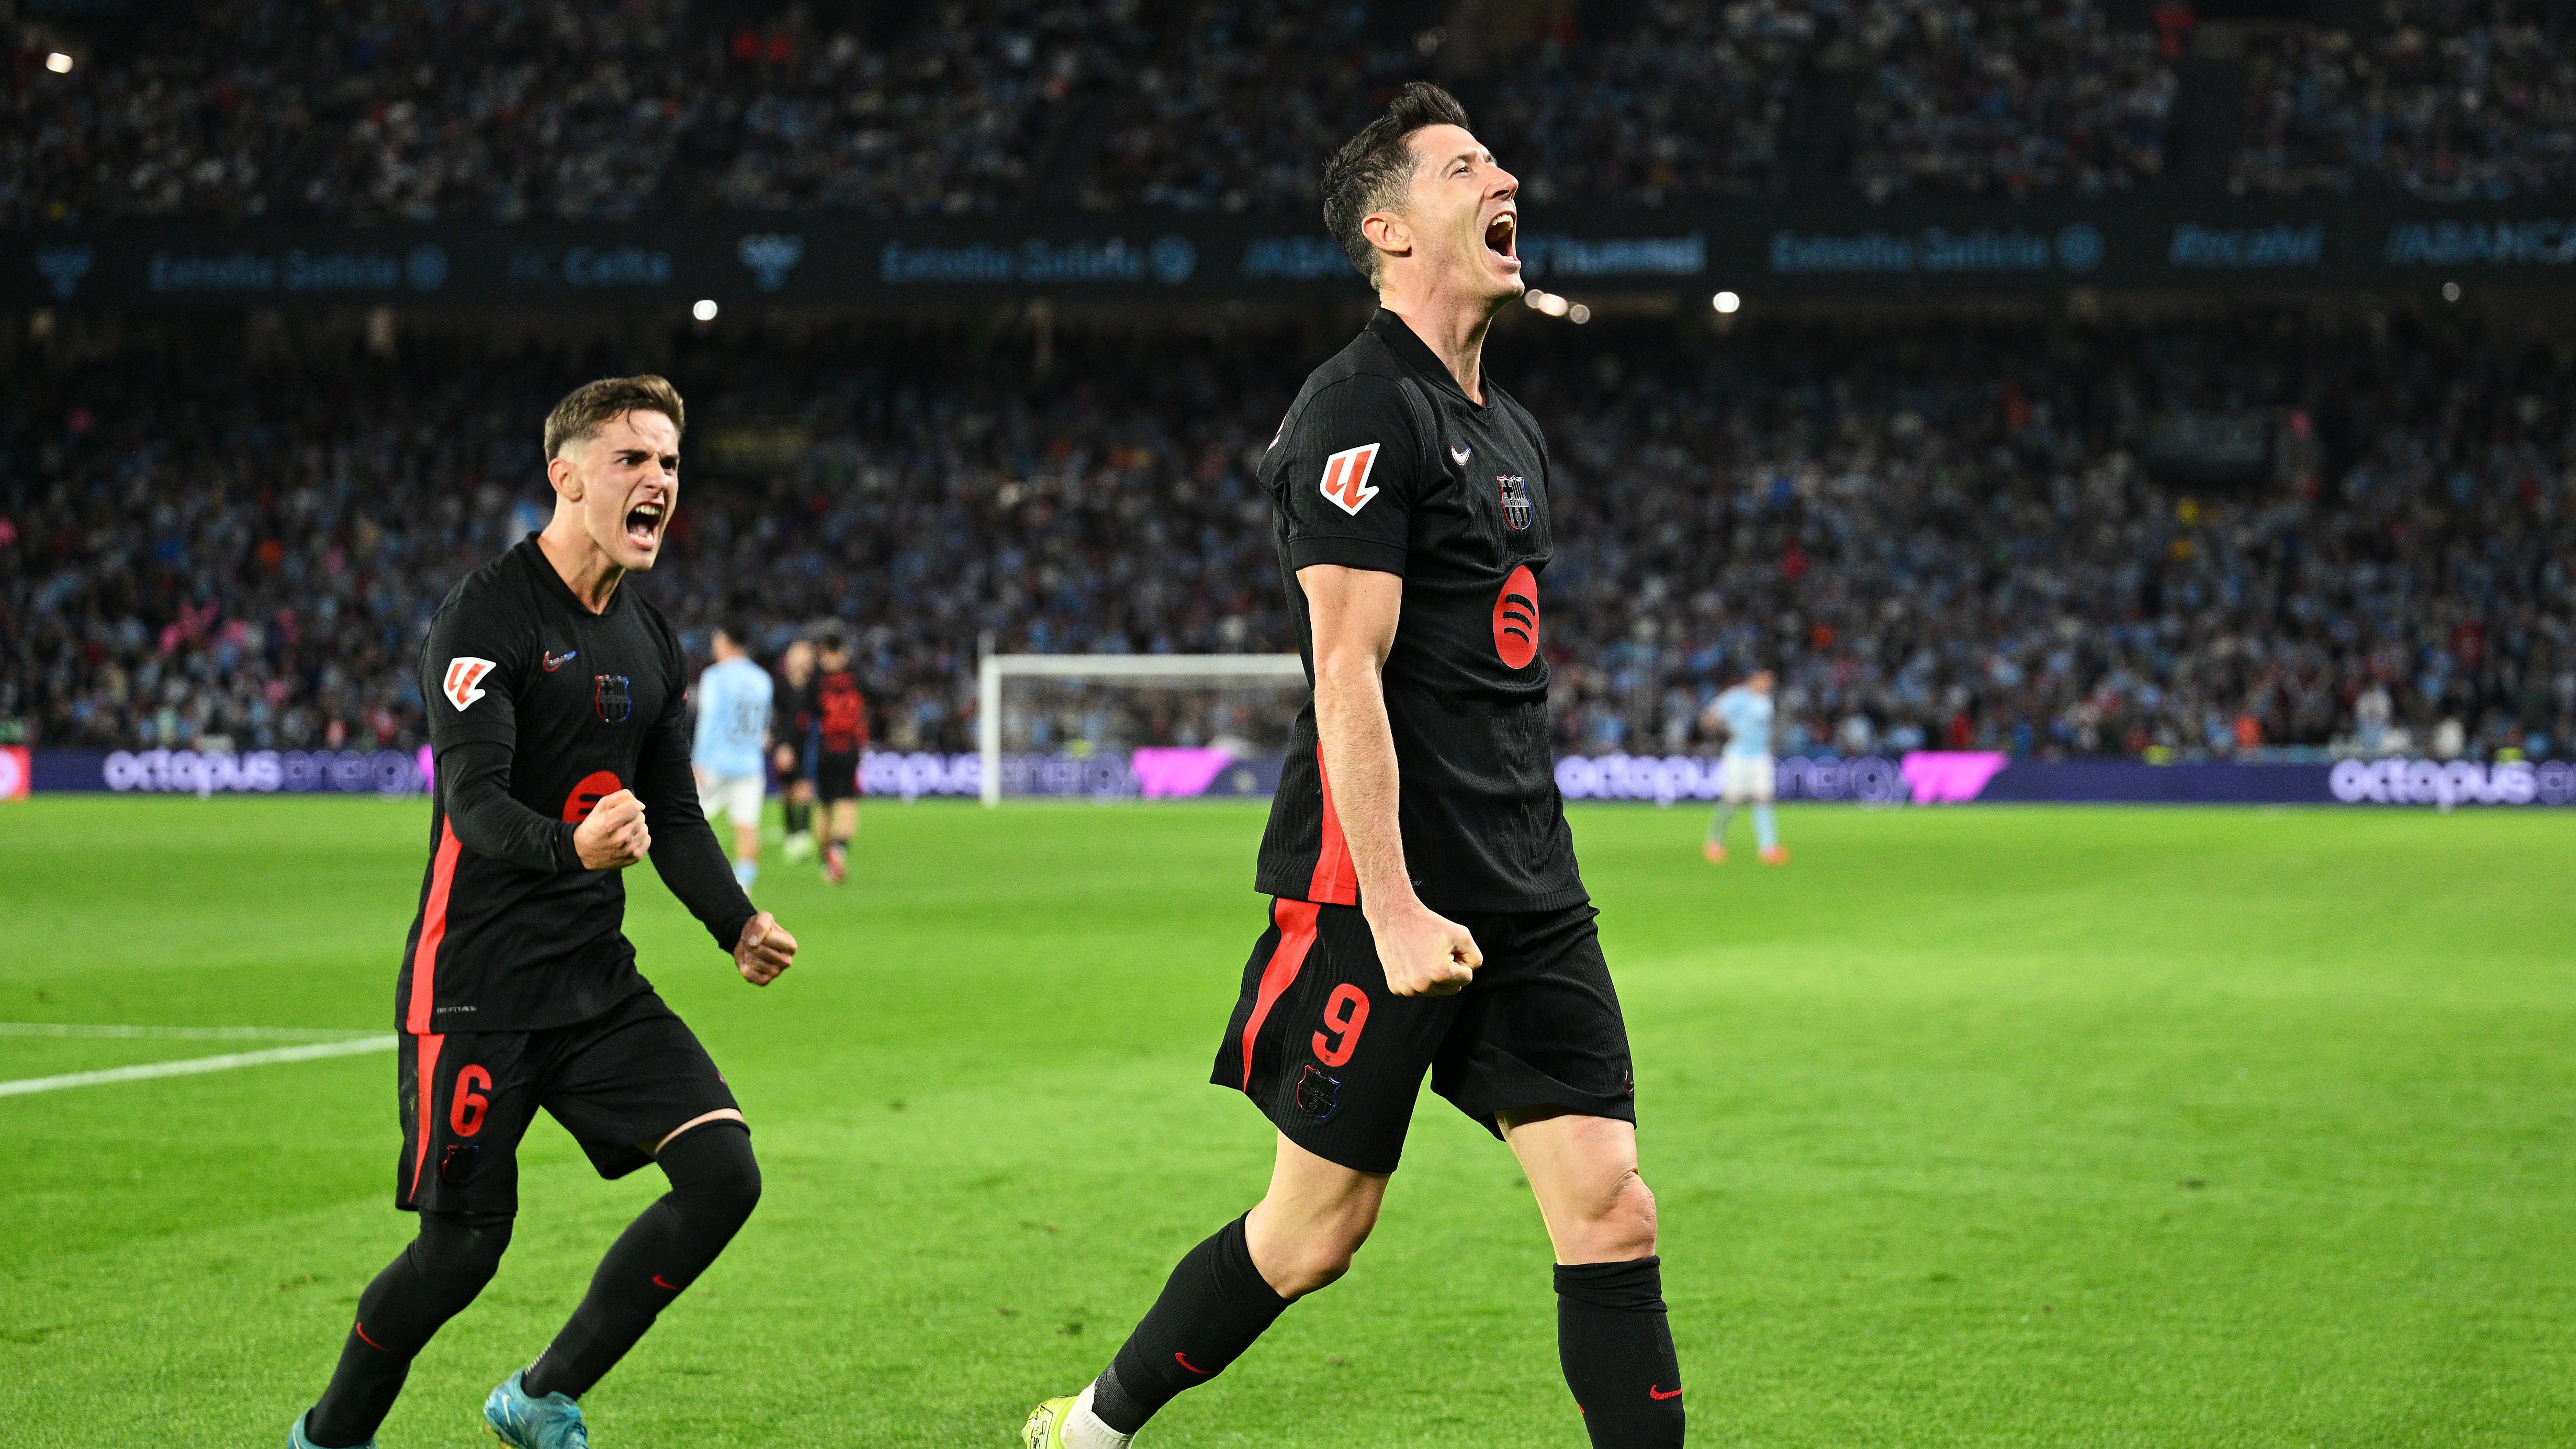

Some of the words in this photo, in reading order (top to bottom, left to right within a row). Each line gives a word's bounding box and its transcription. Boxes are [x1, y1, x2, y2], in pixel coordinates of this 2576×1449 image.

[105, 747, 283, 799] octopus
[2330, 755, 2536, 814] octopus
[1312, 983, 1370, 1067] 9
[450, 1064, 492, 1137] 6
